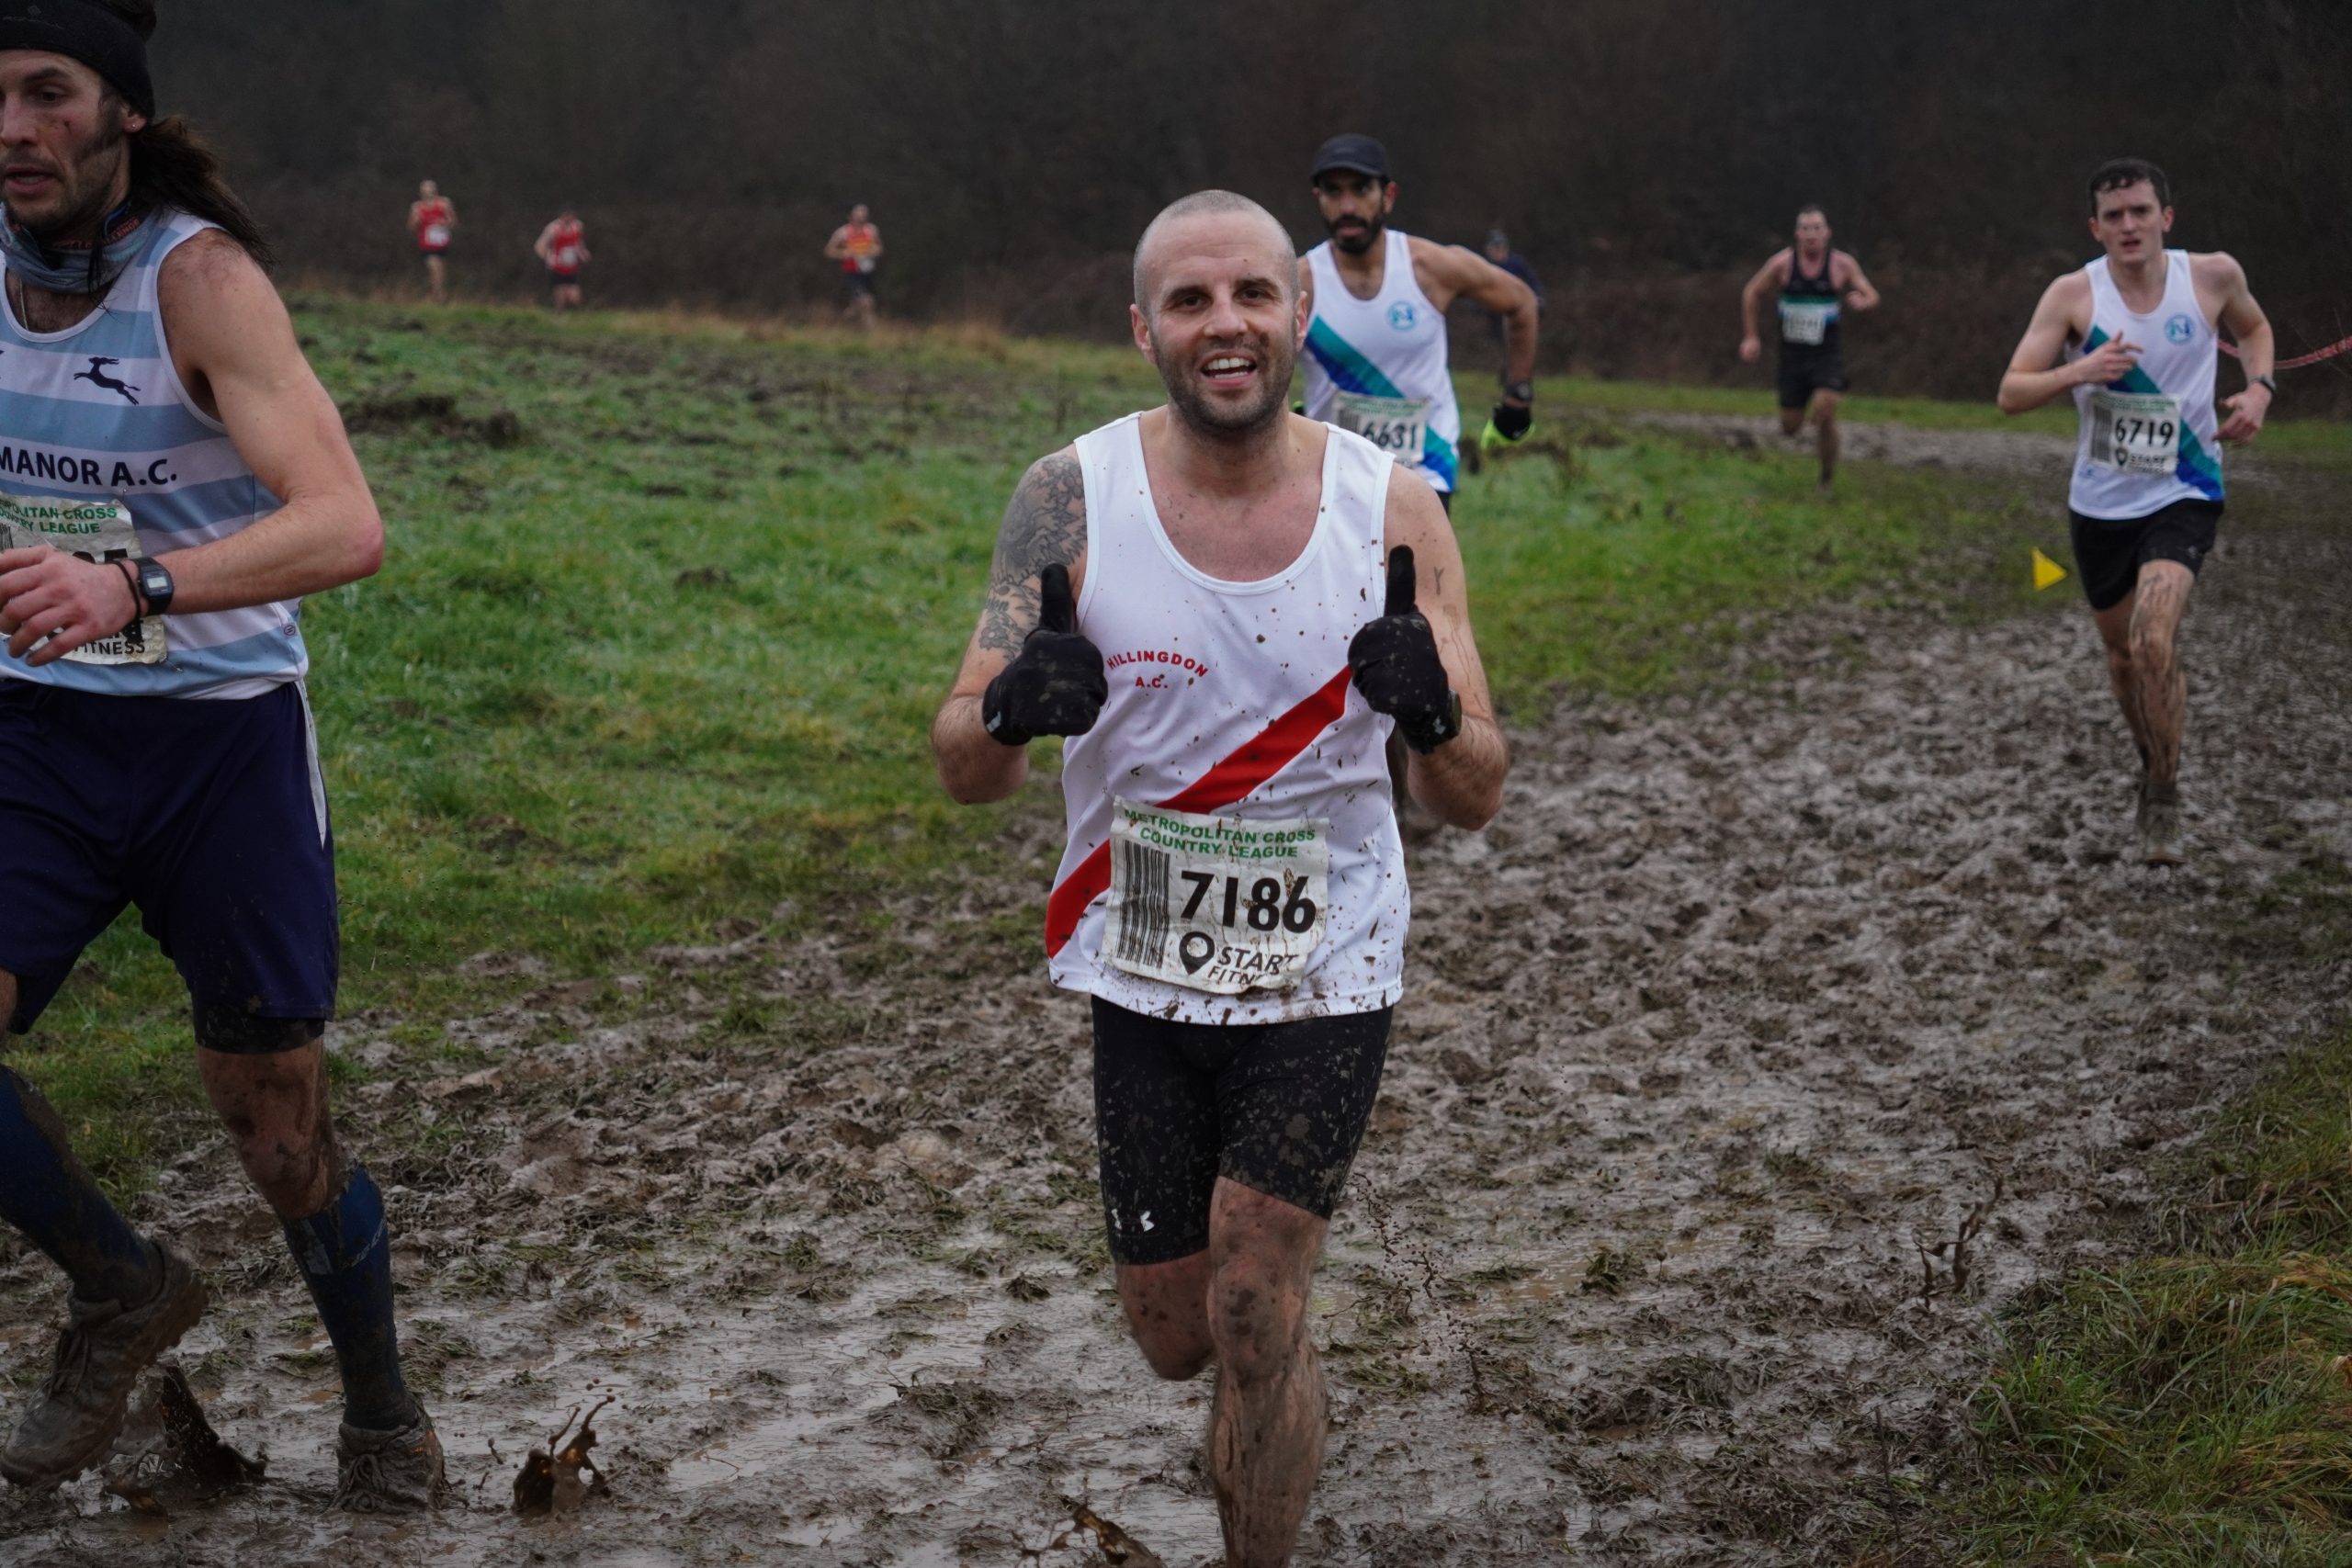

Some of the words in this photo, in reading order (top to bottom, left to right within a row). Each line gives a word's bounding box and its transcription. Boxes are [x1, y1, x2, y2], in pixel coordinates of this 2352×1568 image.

[1363, 422, 1417, 450] 6631
[2115, 417, 2175, 448] 6719
[0, 446, 103, 487] MANOR
[111, 458, 177, 488] A.C.
[40, 521, 101, 535] LEAGUE
[63, 507, 118, 521] CROSS
[1106, 650, 1209, 677] HILLINGDON
[1135, 676, 1169, 689] A.C.
[1124, 808, 1257, 843] METROPOLITAN
[1262, 829, 1316, 843] CROSS
[1140, 827, 1223, 854] COUNTRY
[1227, 845, 1298, 859] LEAGUE
[1180, 869, 1317, 934] 7186
[1217, 946, 1300, 975] START
